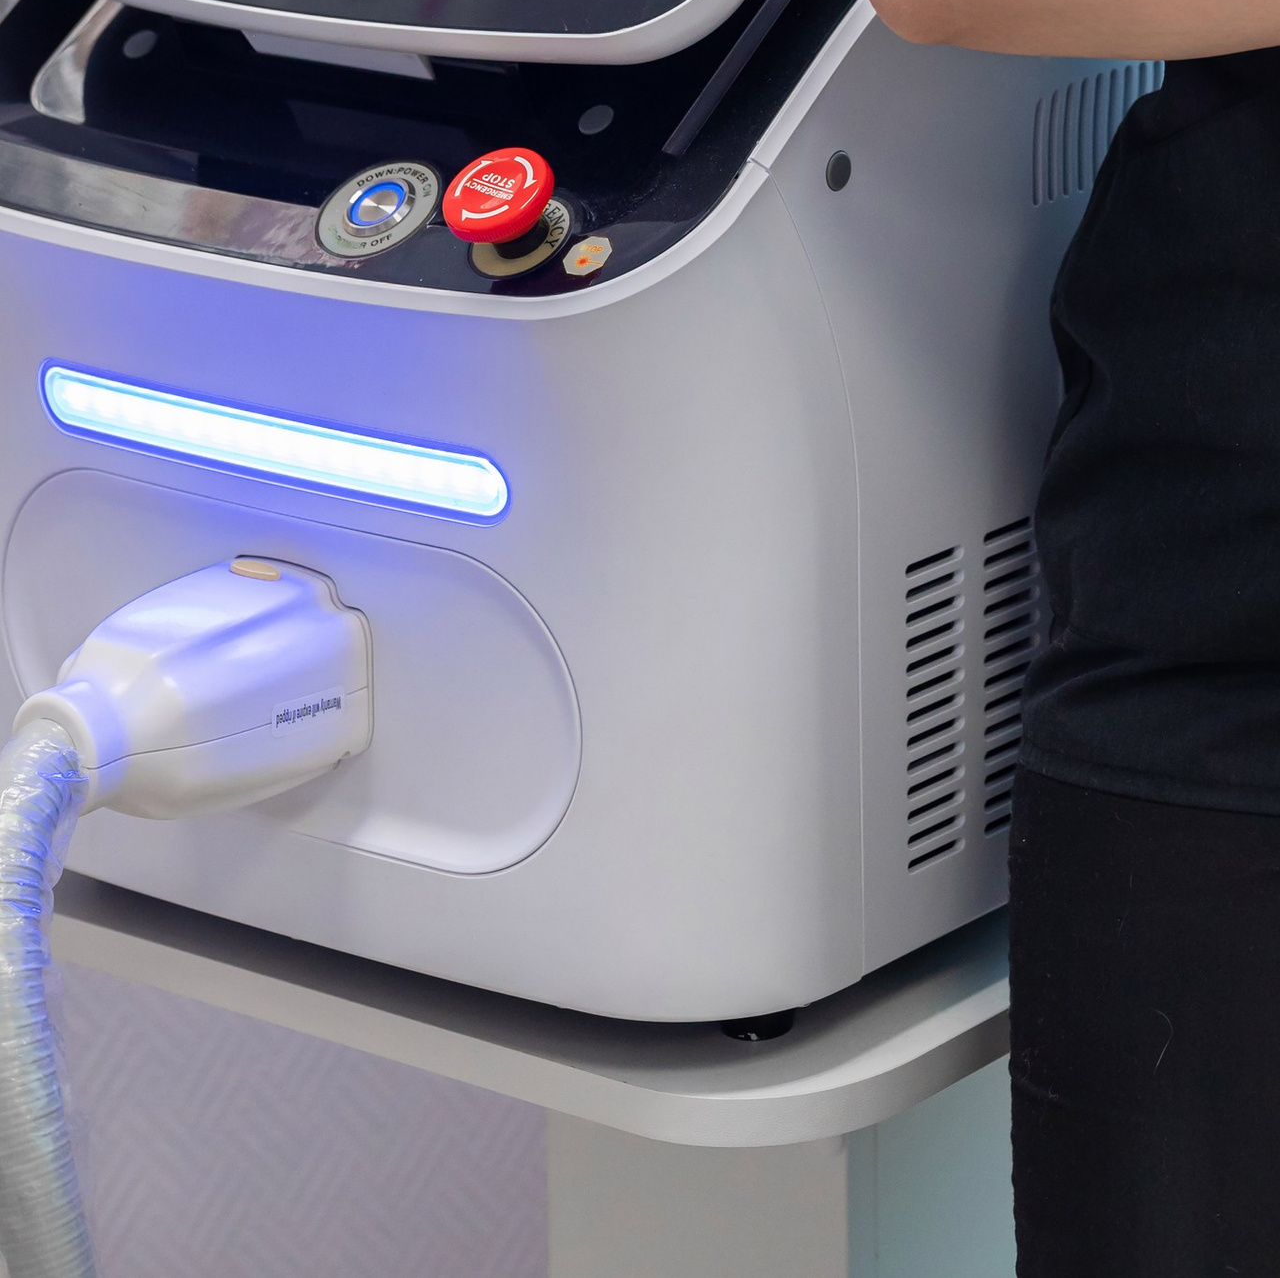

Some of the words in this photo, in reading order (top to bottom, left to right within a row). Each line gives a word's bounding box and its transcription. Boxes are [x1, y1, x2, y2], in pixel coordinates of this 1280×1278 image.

[481, 172, 516, 188] STOP
[464, 180, 514, 201] EMERGENCY
[370, 233, 393, 248] OFF
[296, 704, 312, 721] expire
[311, 703, 320, 717] will
[320, 696, 342, 713] Warranty
[275, 708, 292, 728] ripped
